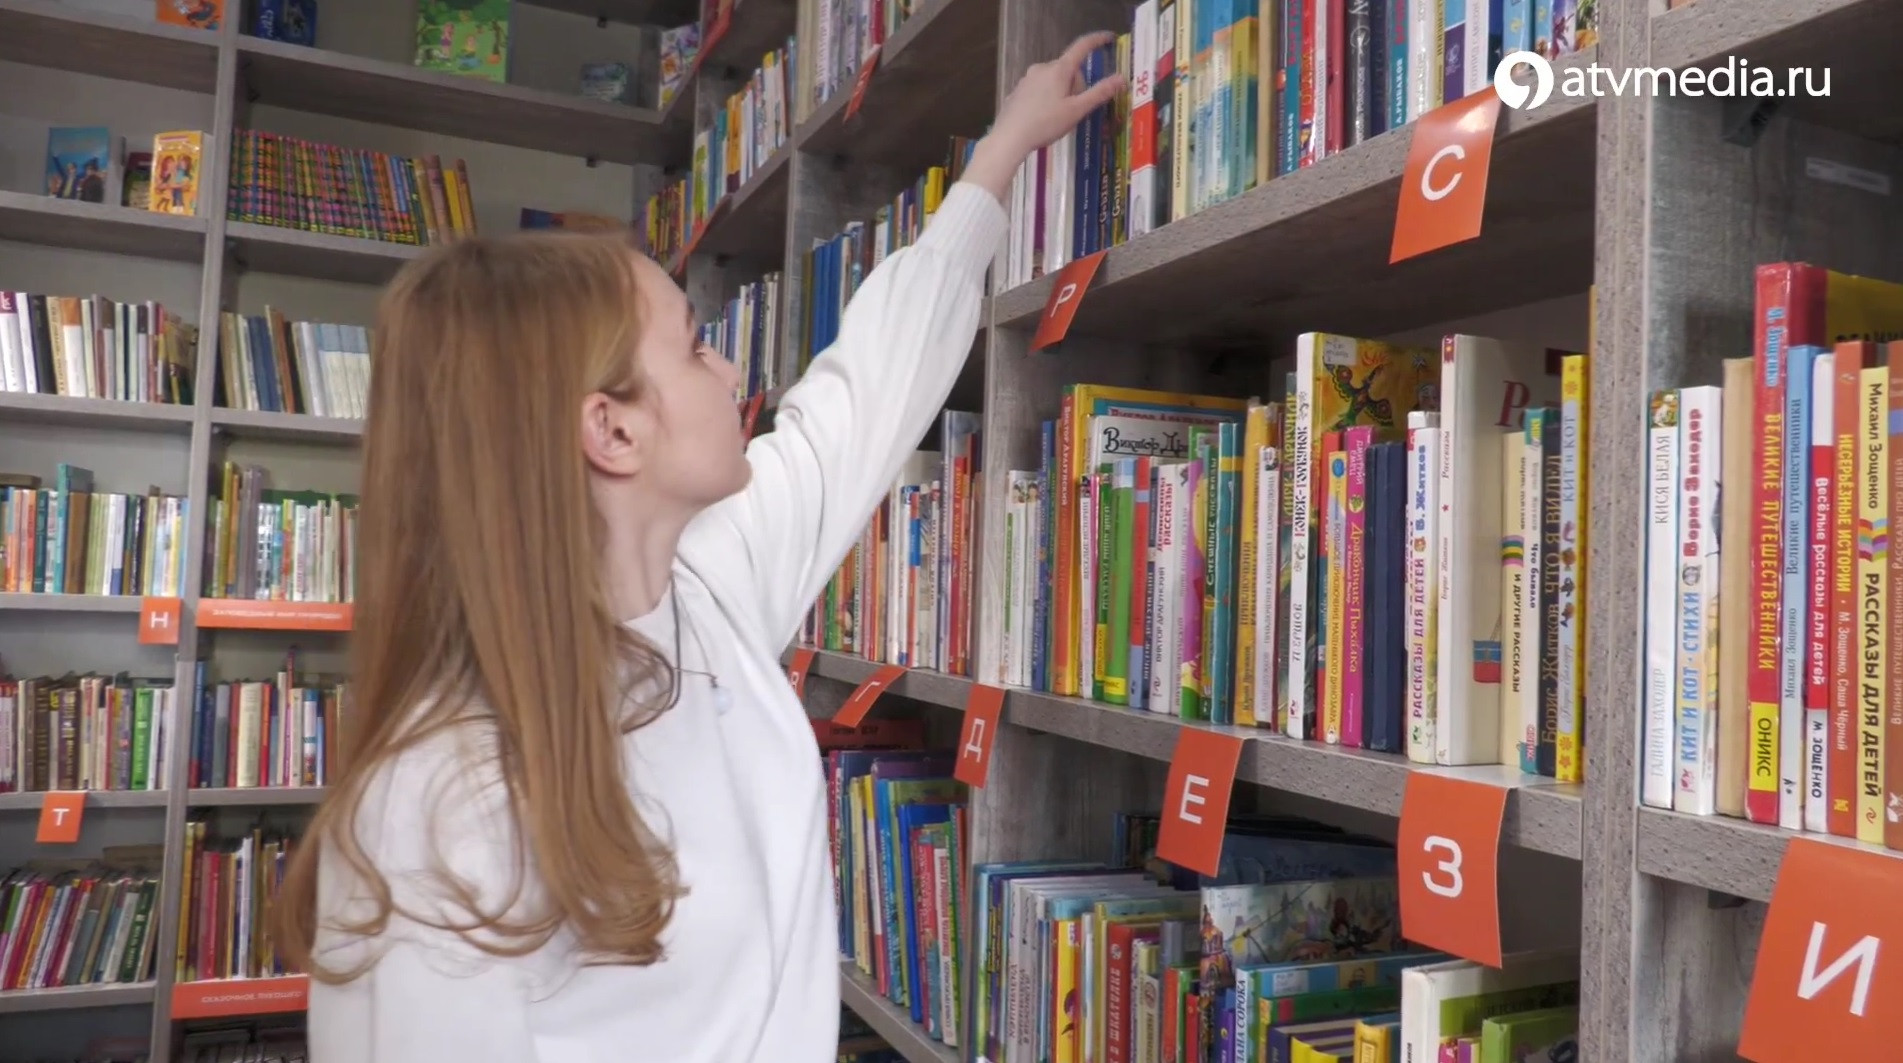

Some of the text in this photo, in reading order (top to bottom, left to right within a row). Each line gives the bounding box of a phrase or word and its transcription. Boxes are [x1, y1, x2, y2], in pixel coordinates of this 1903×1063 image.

[1099, 174, 1109, 223] Goblin
[1112, 168, 1122, 217] Goblin
[1420, 143, 1465, 201] С
[1050, 282, 1077, 318] Р
[1441, 430, 1451, 480] Рассказы
[1562, 415, 1576, 449] КОТ
[1684, 409, 1701, 492] Заходер
[1866, 383, 1883, 510] Михаил Зощенко
[1562, 467, 1575, 503] КИТ
[1654, 435, 1670, 524] КИСЯ БЕЛАЯ
[1163, 483, 1174, 546] рассказы
[1758, 413, 1781, 670] ВЕЛИКИЕ ПУТЕШЕСТВЕННИКИ
[1529, 543, 1540, 609] Что бывало
[1784, 399, 1804, 699] Михаил Зощенко Великие путешественники
[1836, 529, 1852, 592] ИСТОРИИ
[1541, 454, 1562, 743] Борис Житков ЧТО Я ВИДЕЛ
[1811, 477, 1830, 686] Весёлые рассказы для детей
[150, 610, 168, 629] Н
[1154, 626, 1164, 663] ВИКТОР
[1412, 558, 1426, 719] РАССКАЗЫ ДЛЯ ДЕТЕЙ
[1511, 574, 1522, 693] И ДРУГИЕ РАССКАЗЫ
[1681, 592, 1698, 653] СТИХИ
[855, 680, 882, 703] Г
[1834, 611, 1851, 751] М. Зощенко, Саша Чёрный
[1862, 573, 1882, 797] РАССКАЗЫ ДЛЯ ДЕТЕЙ
[964, 717, 986, 764] Д
[1650, 668, 1666, 777] ГАЛИНА ЗАХОДЕР
[1682, 666, 1698, 763] КИТ И КОТ
[1756, 717, 1772, 777] ОНИКС
[1810, 736, 1823, 798] ЗОЩЕНКО
[52, 807, 71, 827] Т
[1178, 773, 1210, 825] Е
[1797, 919, 1881, 1018] И
[1108, 966, 1121, 1041] ШКАТУЛКЕ
[1236, 979, 1247, 1029] СОРОКА
